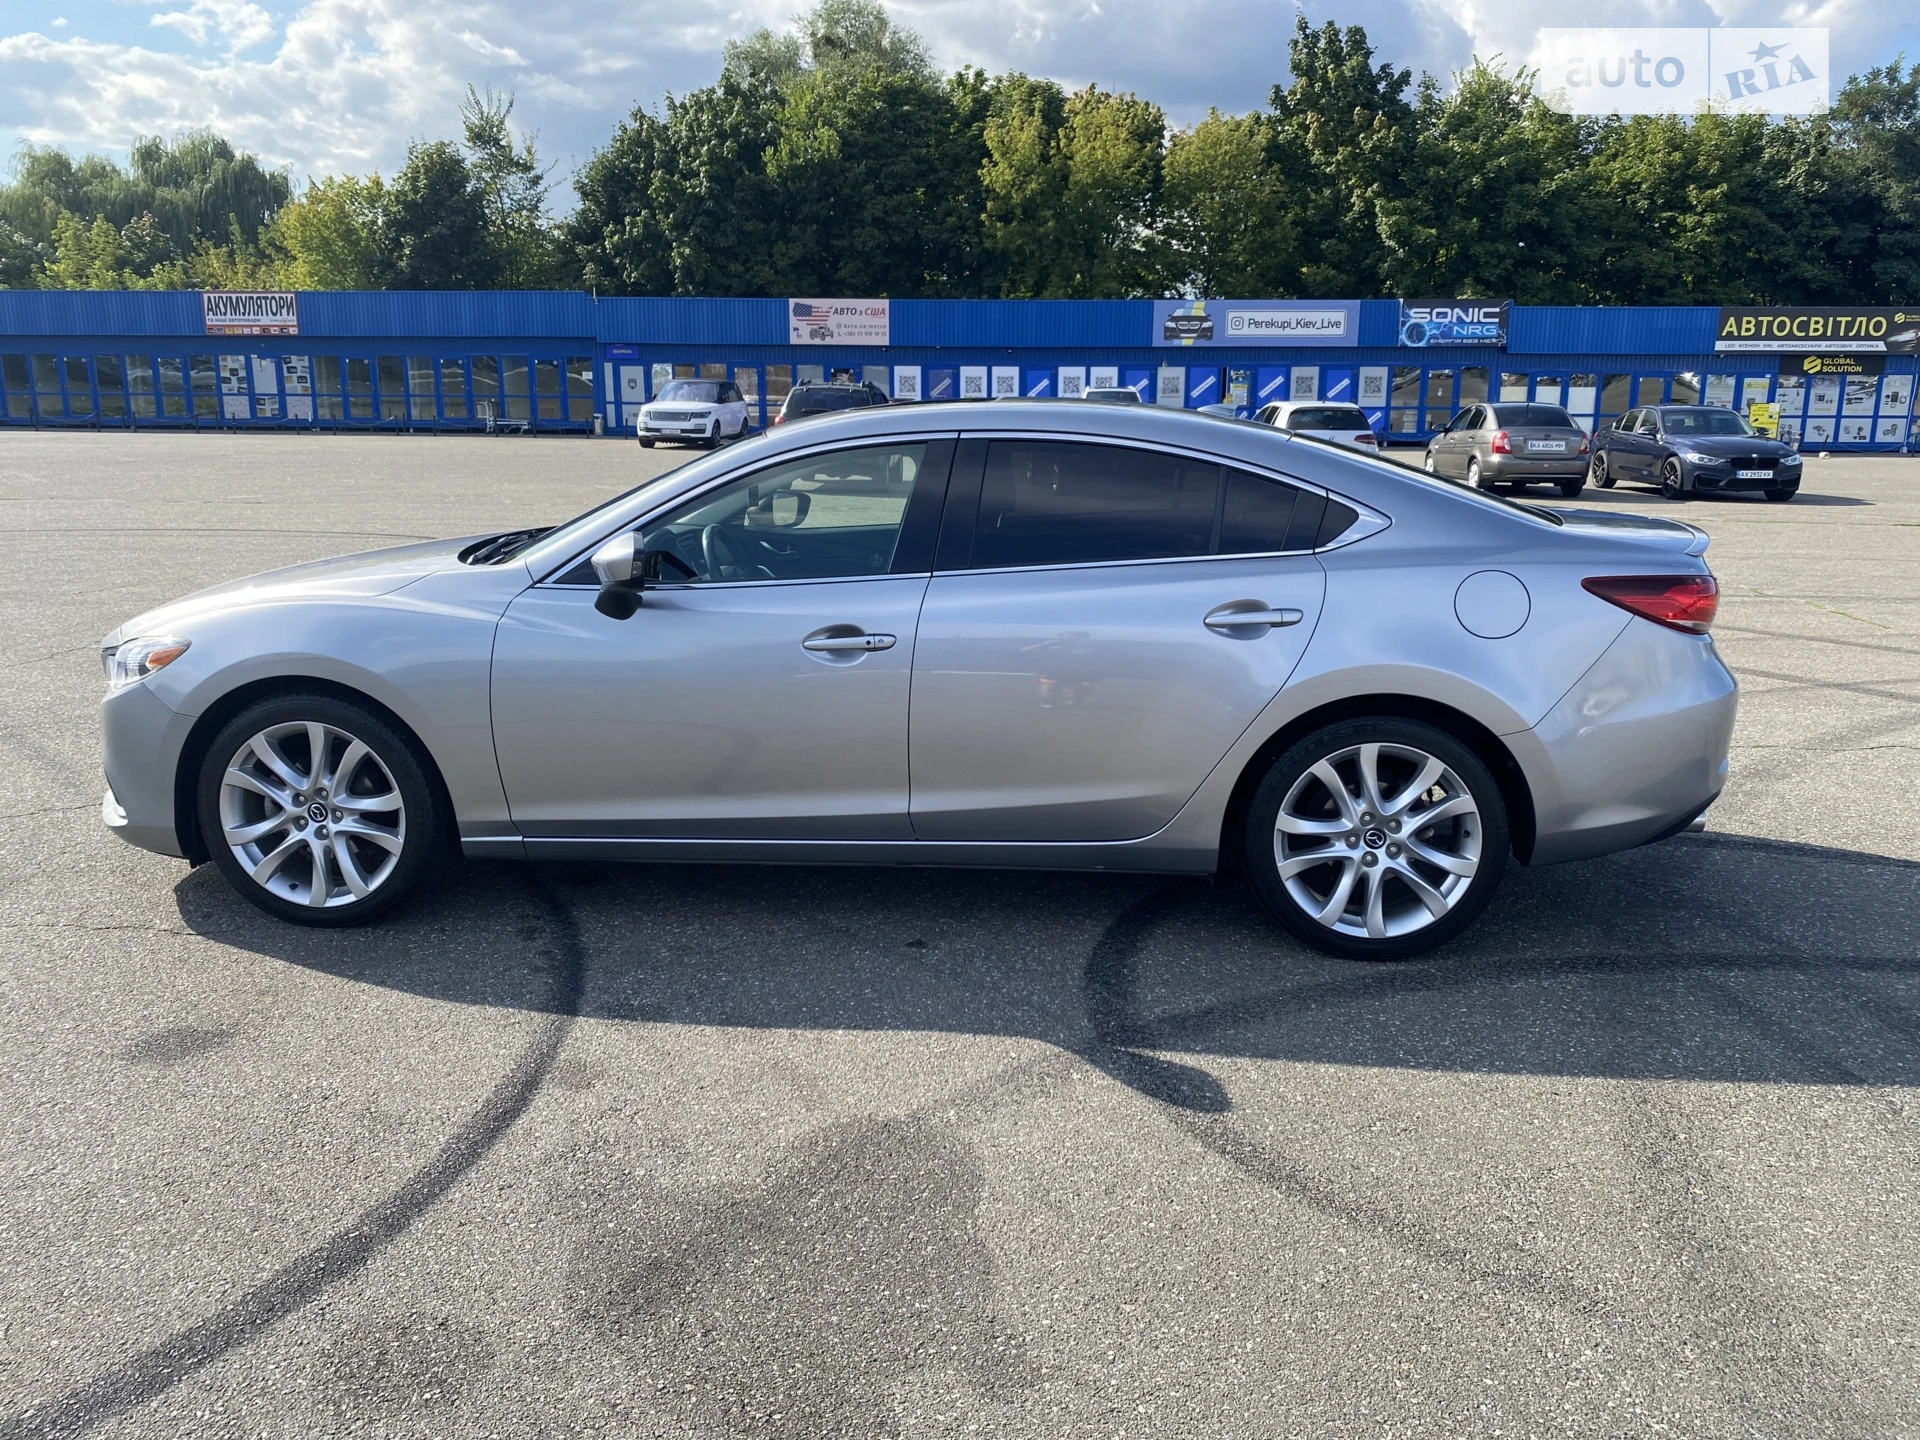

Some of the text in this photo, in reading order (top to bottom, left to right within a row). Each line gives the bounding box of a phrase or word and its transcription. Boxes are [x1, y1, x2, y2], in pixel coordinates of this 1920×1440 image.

[206, 295, 295, 317] АКУМУЛЯТОРИ
[833, 307, 857, 316] АВТО
[864, 307, 886, 316] США
[1410, 308, 1500, 323] SONIC
[1248, 318, 1342, 331] Perekupi_Kiev_Live
[1453, 325, 1497, 335] NRG
[1721, 316, 1888, 337] АВТОСВІТЛО
[1823, 357, 1856, 365] GLOBAL
[1822, 365, 1862, 373] SOLUTION
